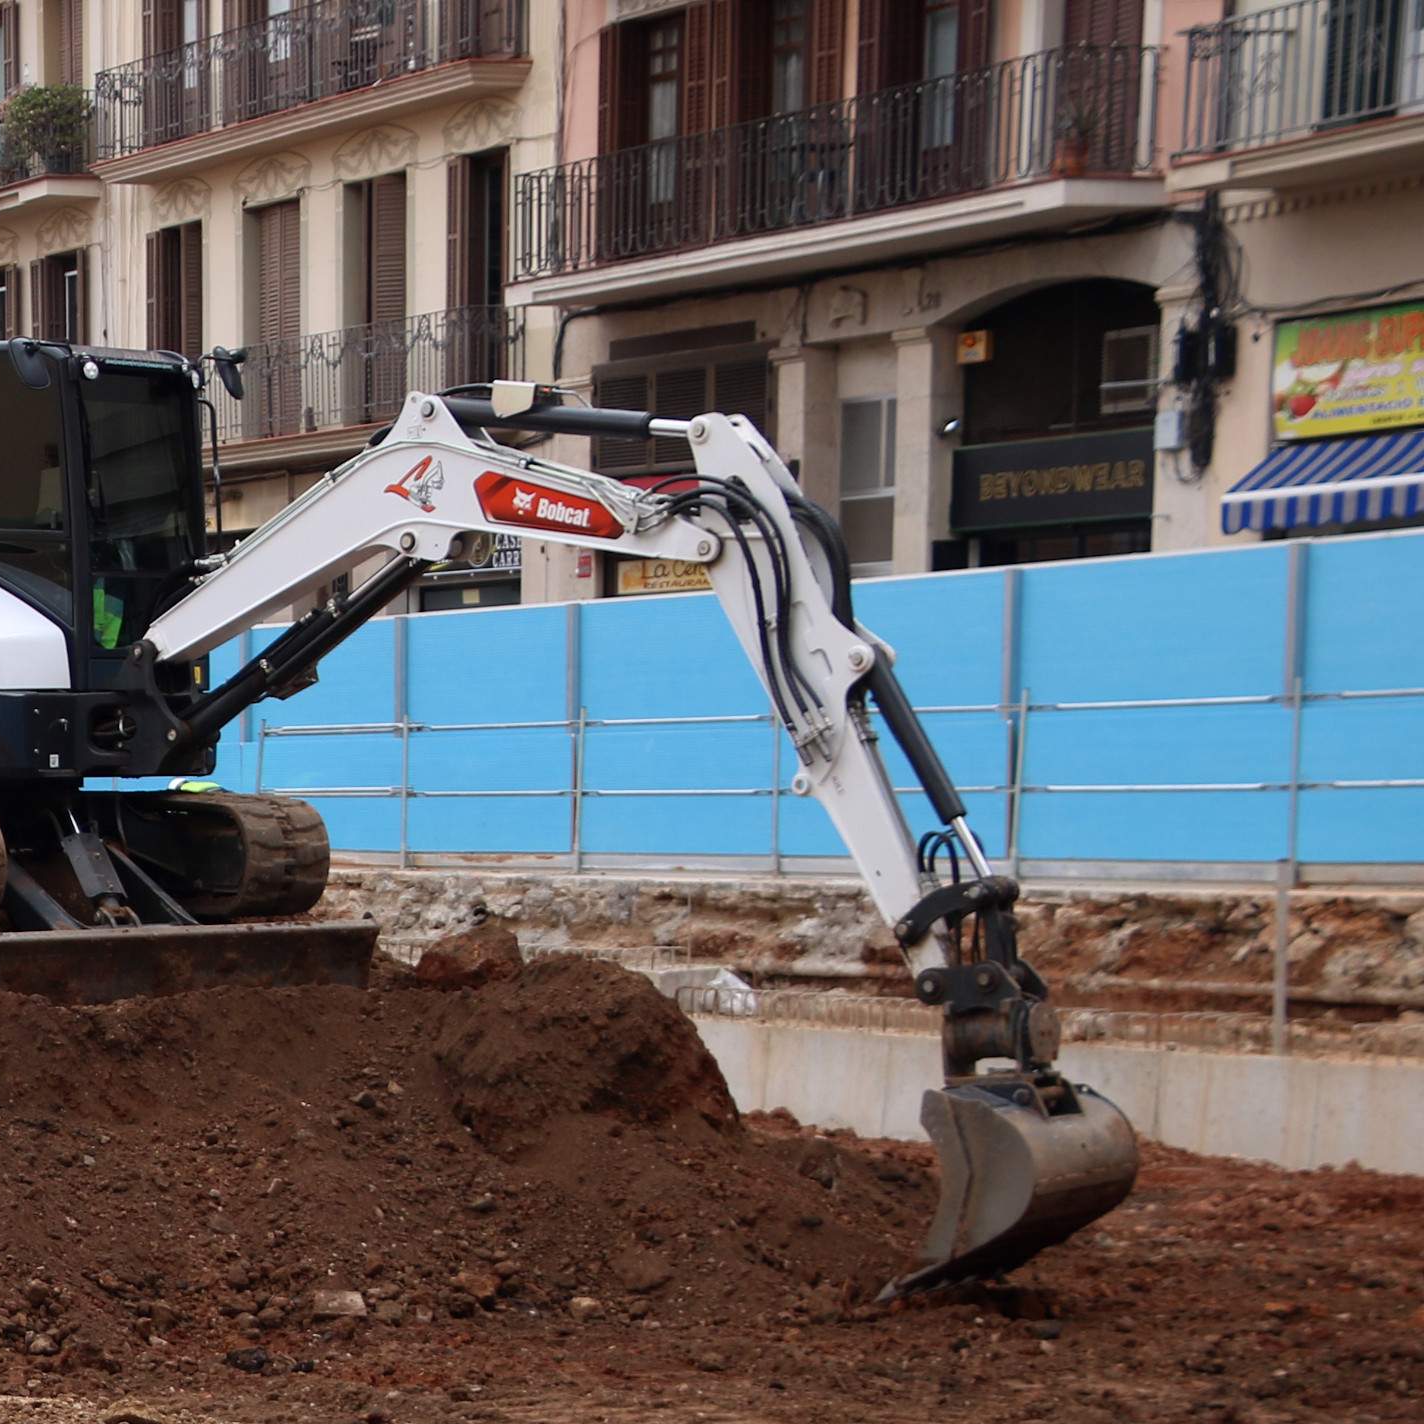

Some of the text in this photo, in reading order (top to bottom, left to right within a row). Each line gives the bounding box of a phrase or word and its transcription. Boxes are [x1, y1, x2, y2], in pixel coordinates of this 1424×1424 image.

[979, 459, 1146, 501] BEYONDWEAR
[536, 499, 590, 528] Bobcat
[641, 560, 668, 579] La
